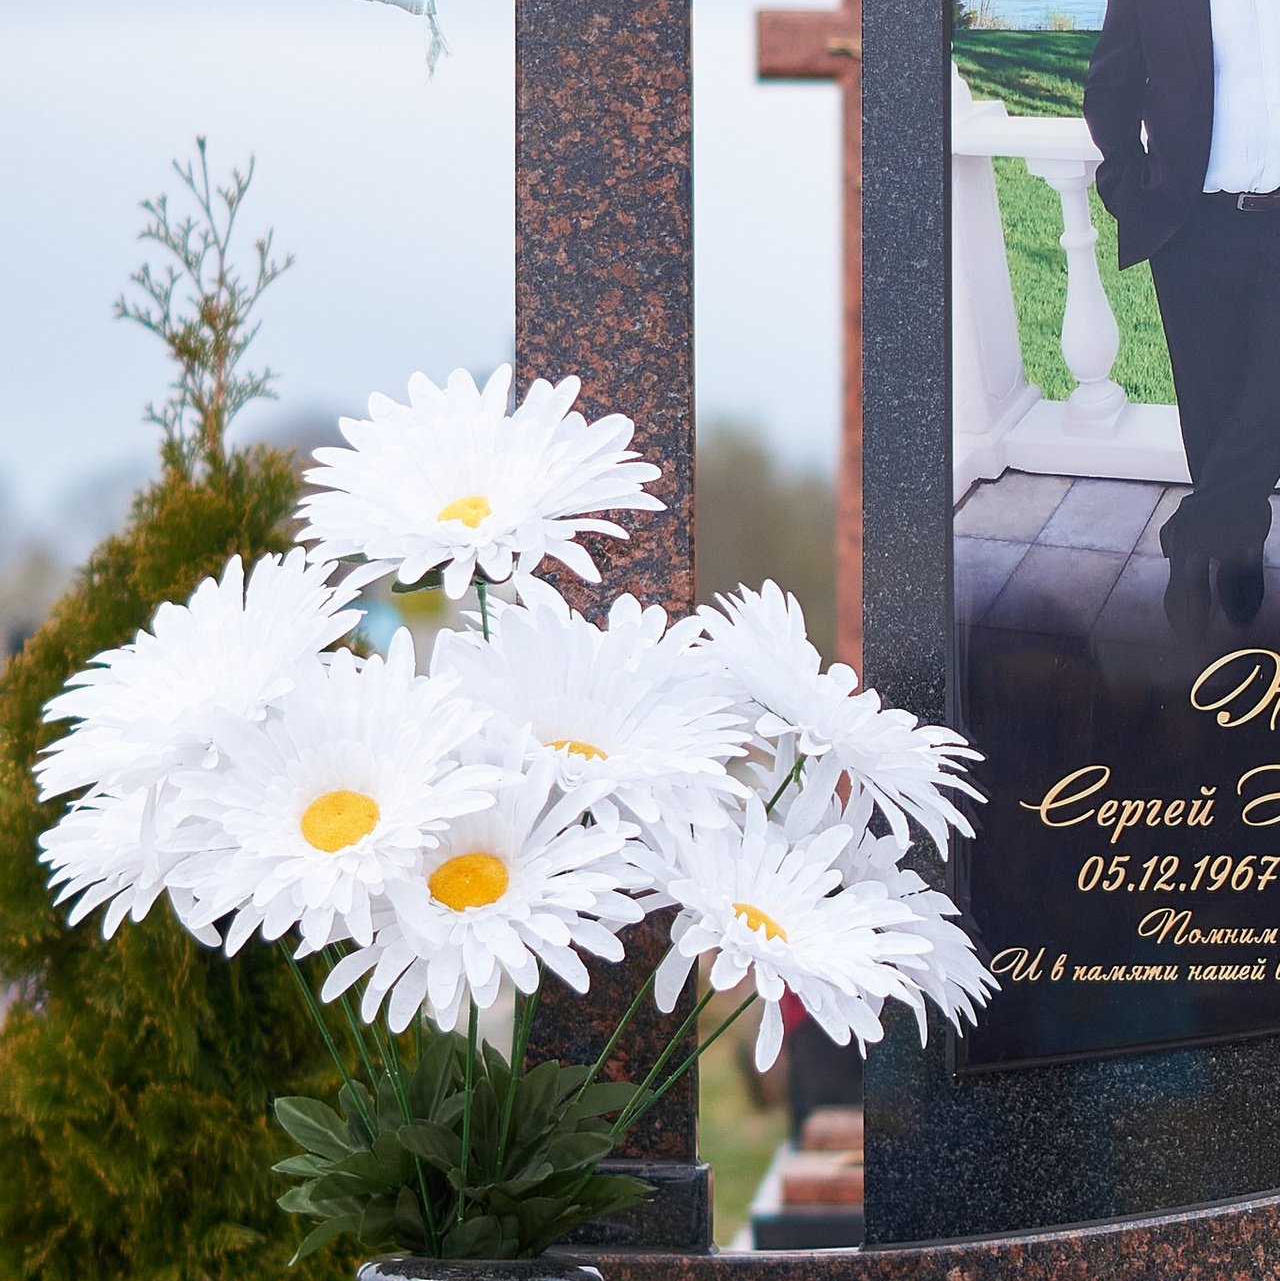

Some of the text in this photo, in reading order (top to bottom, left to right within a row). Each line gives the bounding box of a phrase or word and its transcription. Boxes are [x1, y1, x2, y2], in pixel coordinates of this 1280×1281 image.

[1019, 765, 1217, 844] Сергей
[1137, 907, 1279, 945] Помним
[990, 947, 1045, 982] И
[1050, 953, 1068, 982] в
[1072, 964, 1180, 982] памяти
[1187, 957, 1268, 982] нашей
